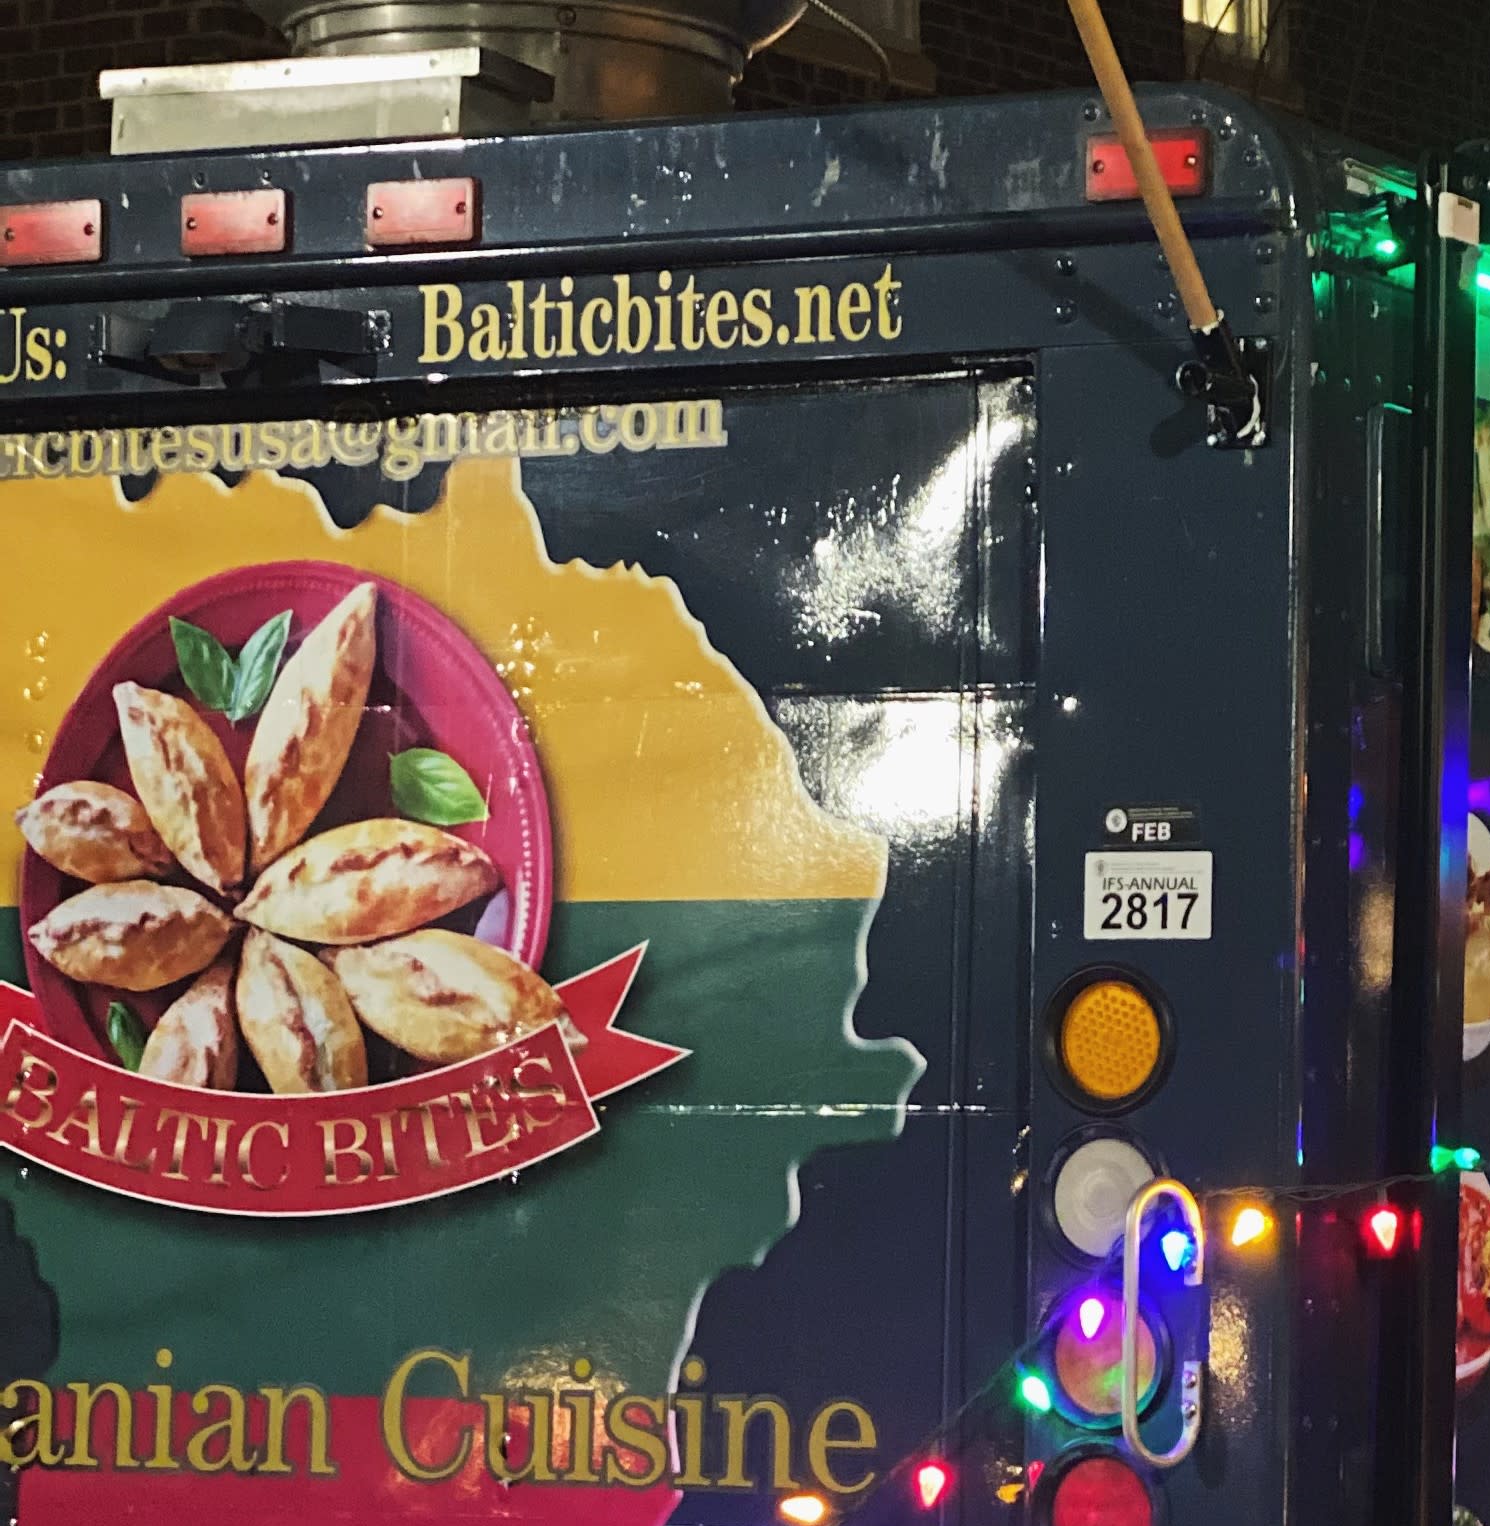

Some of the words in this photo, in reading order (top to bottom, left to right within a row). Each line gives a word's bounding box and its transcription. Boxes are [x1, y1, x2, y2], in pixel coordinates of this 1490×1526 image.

[418, 262, 903, 364] Balticbites.net
[1131, 821, 1172, 843] FEB
[1101, 892, 1199, 930] 2817
[1102, 877, 1198, 890] IFS-ANNUAL
[0, 1049, 290, 1191] BALTIC
[316, 1056, 568, 1187] BITES
[382, 1348, 878, 1495] Cuisine
